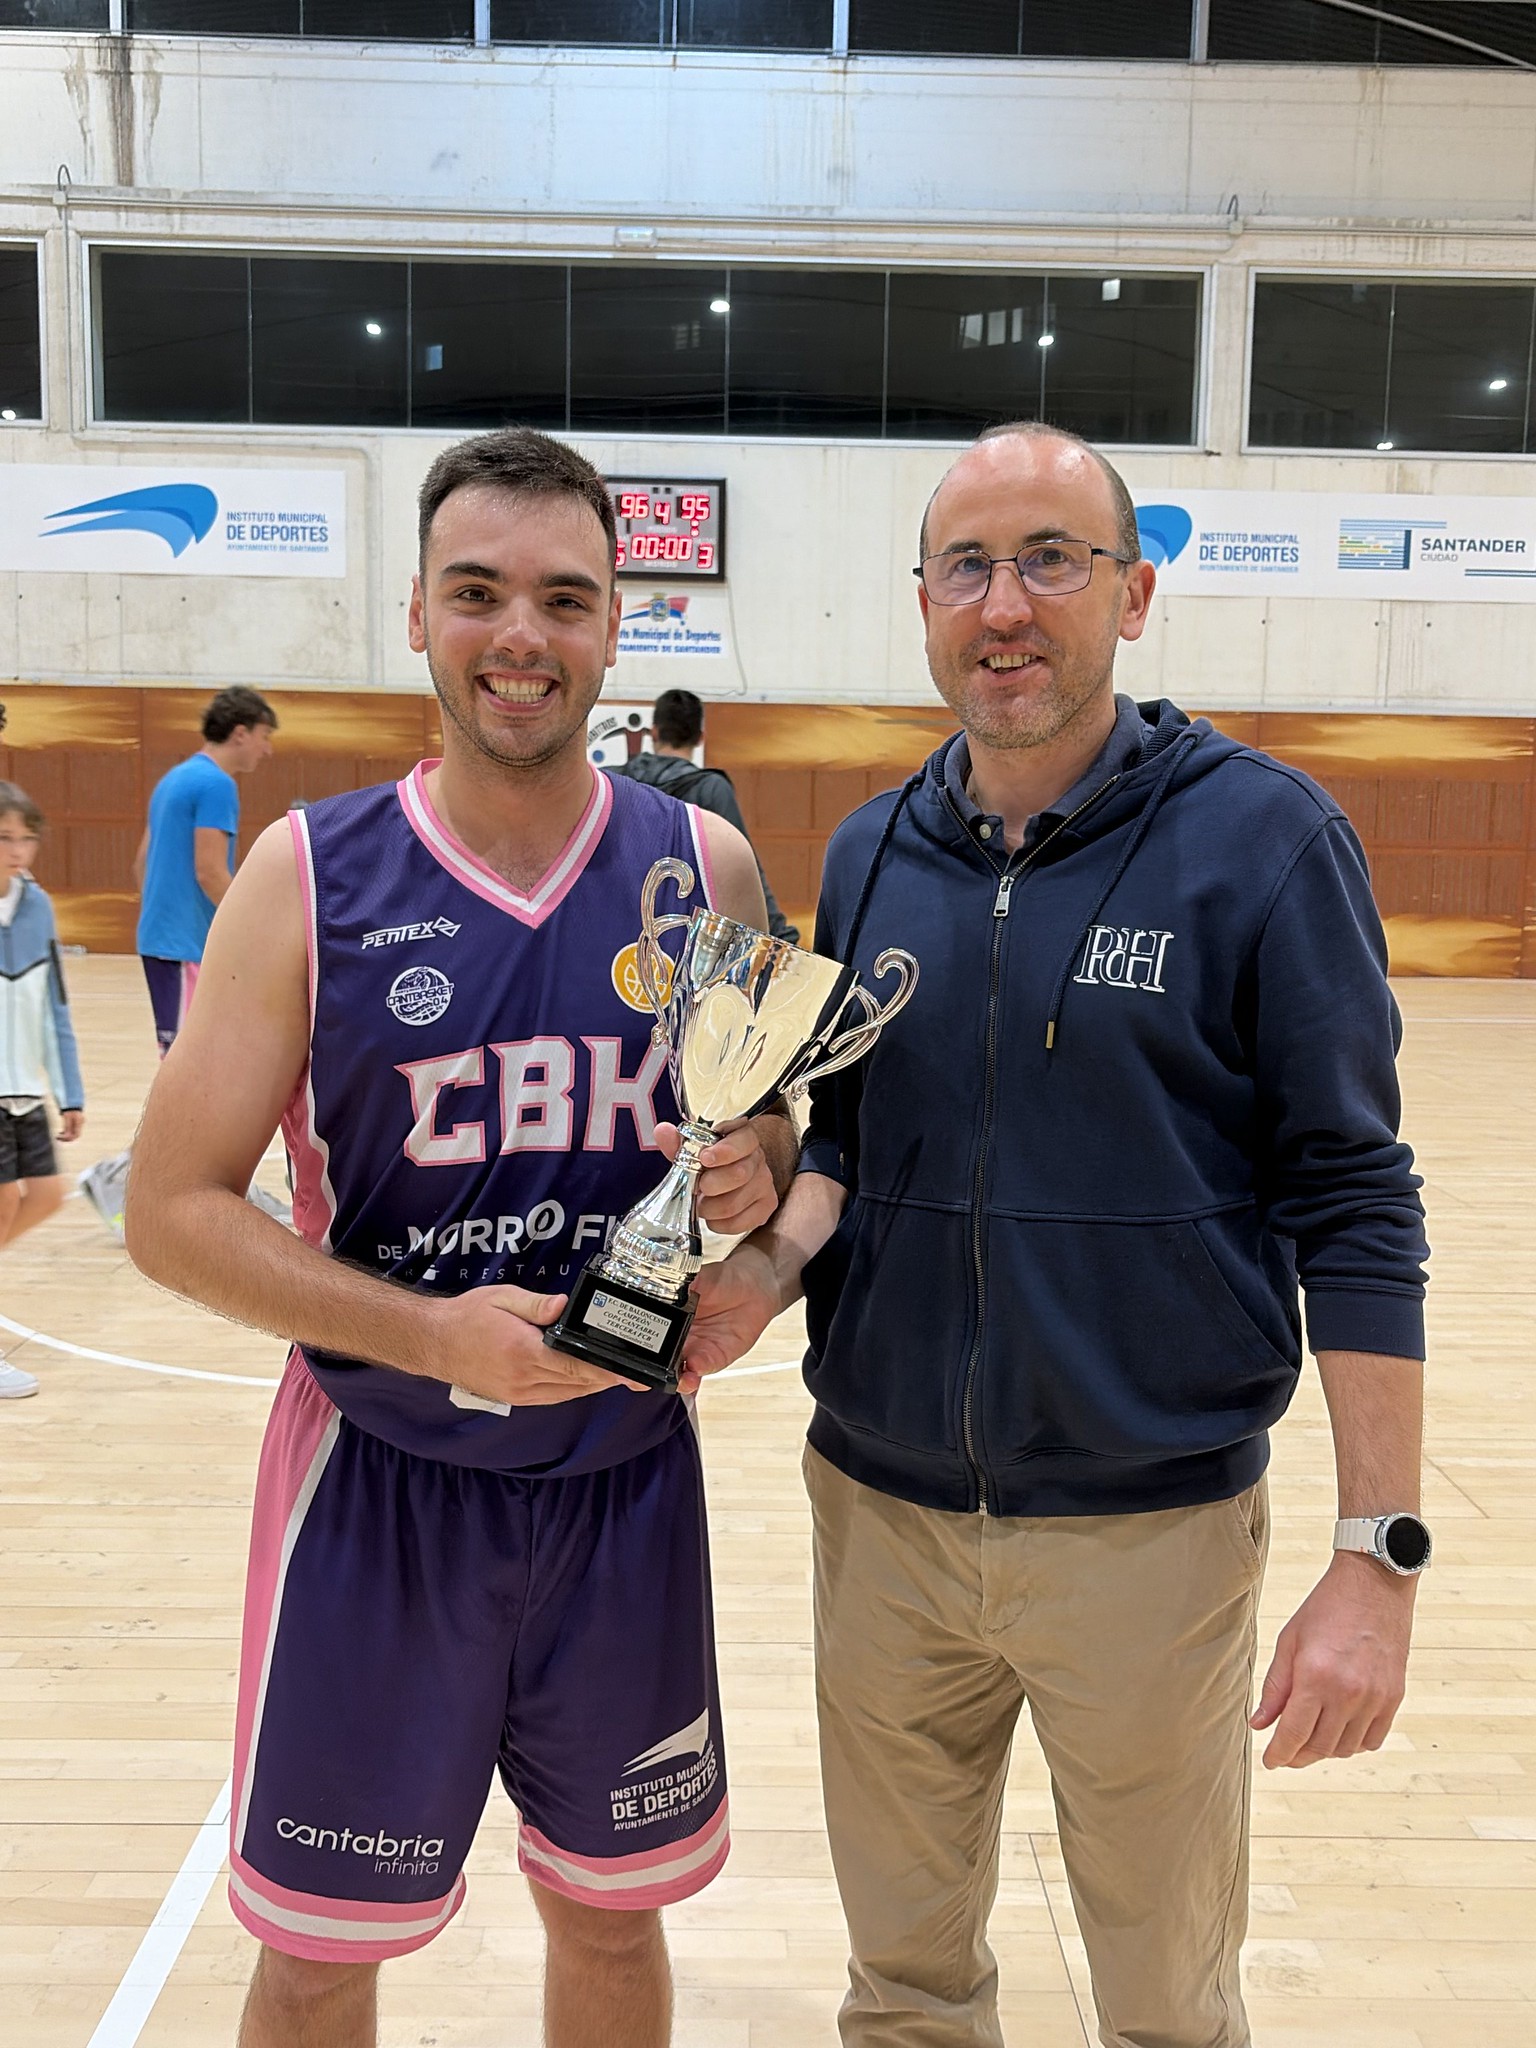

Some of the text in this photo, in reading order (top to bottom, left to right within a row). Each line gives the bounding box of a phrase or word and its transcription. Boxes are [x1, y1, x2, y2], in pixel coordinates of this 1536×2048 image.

[227, 512, 328, 523] INSTITUTO MUNICIPAL
[620, 493, 649, 518] 96
[654, 502, 670, 524] 4
[681, 495, 710, 520] 95
[227, 525, 328, 542] DE DEPORTES
[1200, 533, 1299, 544] INSTITUTO MUNICIPAL
[1421, 538, 1526, 553] SANTANDER
[631, 536, 692, 560] 00:00
[697, 543, 713, 568] 3
[1200, 545, 1299, 562] DE DEPORTES
[1420, 553, 1458, 562] CIUDAD
[394, 1036, 668, 1166] CBK
[377, 1244, 403, 1260] DE
[405, 1199, 565, 1257] MORRO
[610, 1775, 673, 1801] INSTITUTO
[612, 1751, 717, 1820] DE DEPORTES
[614, 1807, 679, 1831] AYUNTAMIENTO
[680, 1802, 691, 1814] DE
[276, 1818, 444, 1857] cantabria
[374, 1857, 439, 1876] infinita
